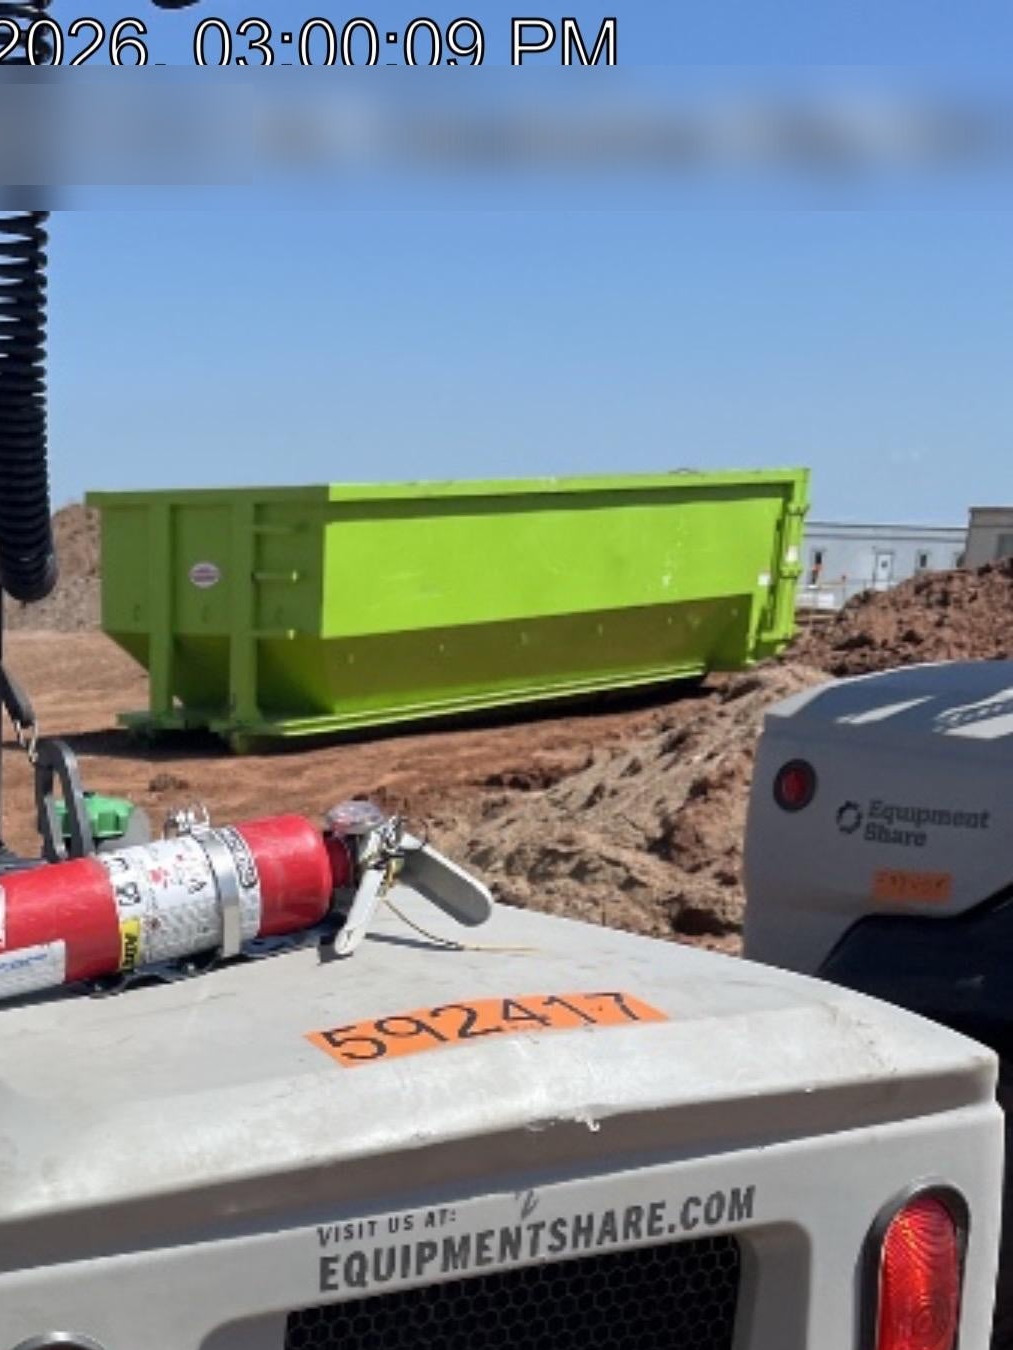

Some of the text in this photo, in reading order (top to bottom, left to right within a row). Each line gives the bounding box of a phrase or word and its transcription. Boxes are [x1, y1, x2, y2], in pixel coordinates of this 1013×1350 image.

[866, 799, 992, 829] Equipment
[863, 821, 928, 847] Share
[321, 991, 641, 1061] 592417
[316, 1208, 457, 1247] VISIT US AT:
[318, 1185, 757, 1293] EQUIPMENTSHARE.COM
